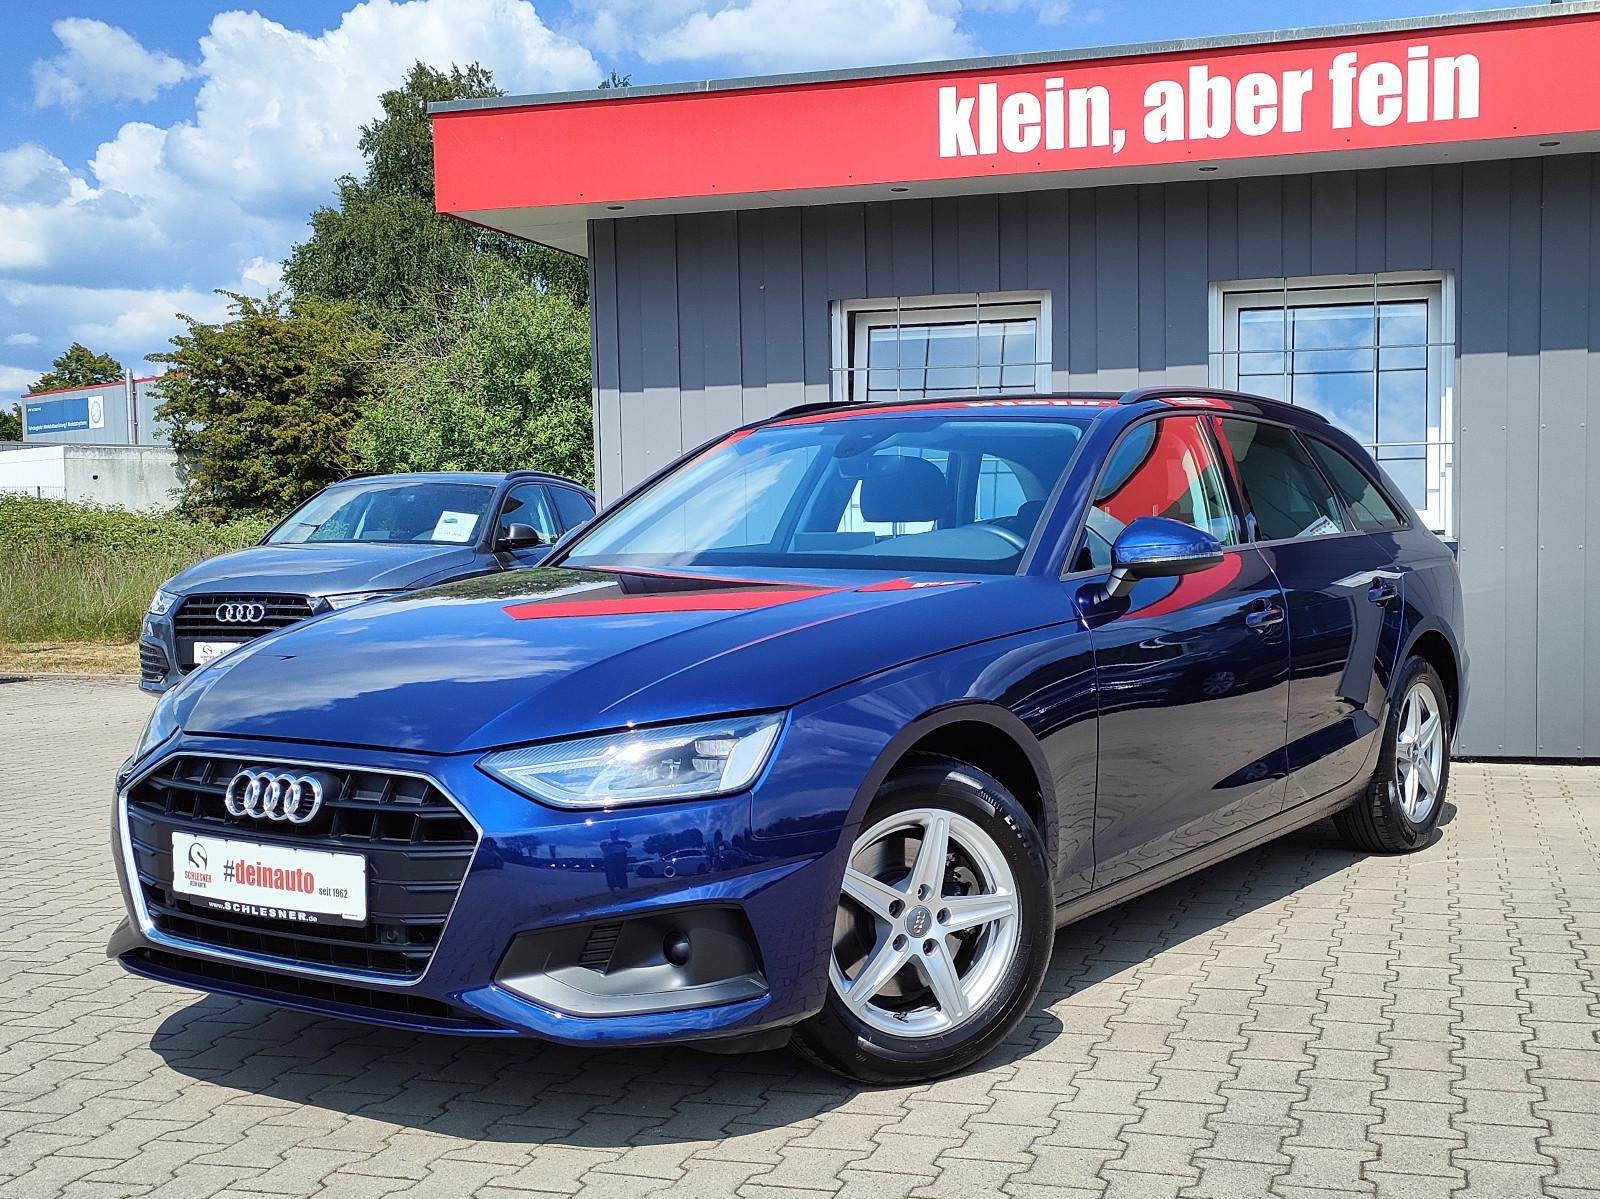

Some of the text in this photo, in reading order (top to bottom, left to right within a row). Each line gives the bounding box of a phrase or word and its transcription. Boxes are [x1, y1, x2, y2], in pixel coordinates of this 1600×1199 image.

[938, 45, 1481, 159] klein, aber fein
[184, 870, 212, 883] SCHLESNER
[223, 859, 315, 894] #deinauto
[318, 886, 348, 899] seit 1962
[208, 902, 318, 923] www.SCHLESNER.de
